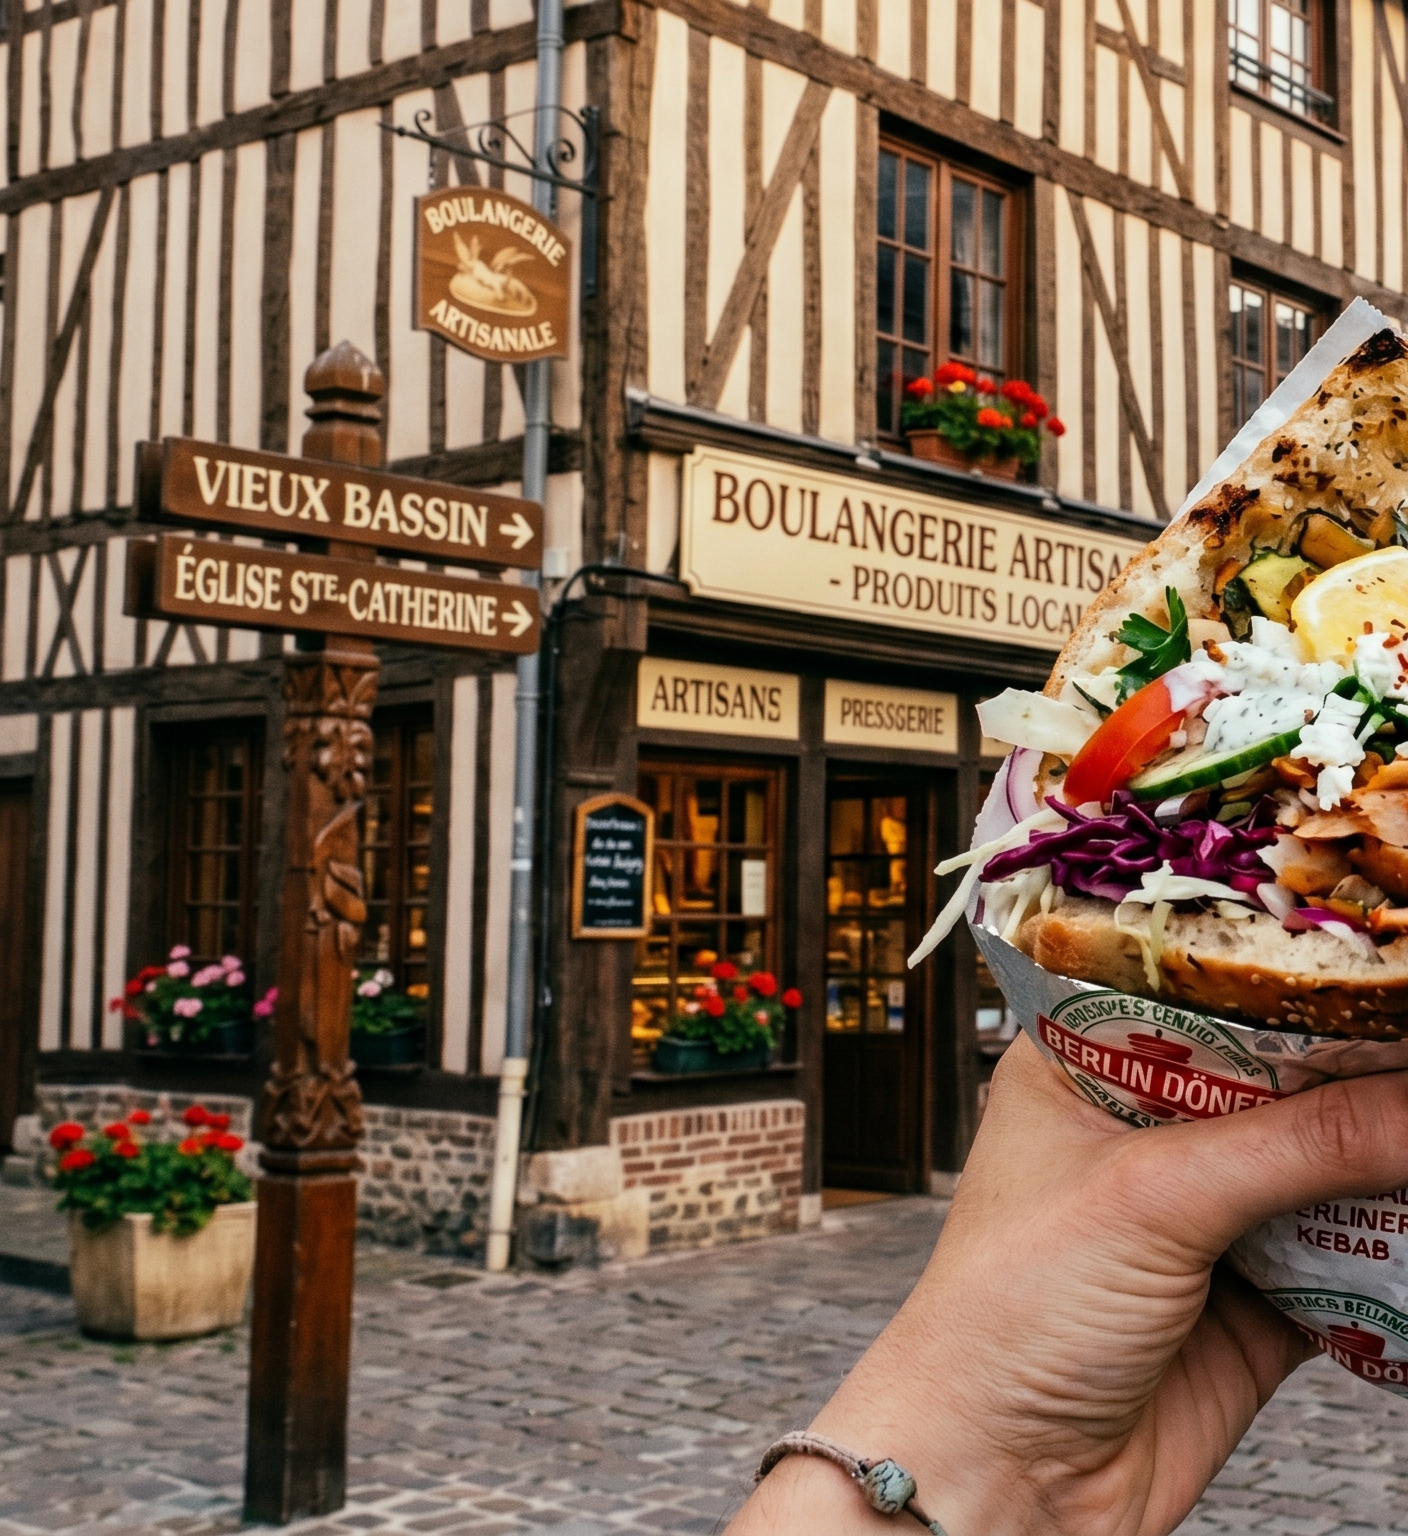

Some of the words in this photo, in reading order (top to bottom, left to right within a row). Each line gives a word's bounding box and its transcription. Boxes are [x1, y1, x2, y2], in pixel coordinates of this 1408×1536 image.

[424, 196, 567, 268] BOULANGERIE
[428, 298, 557, 352] ARTISANALE
[193, 456, 331, 523] VIEUX
[343, 482, 489, 547] BASSIN
[712, 470, 998, 574] BOULANGERIE
[1009, 532, 1131, 593] ARTISA
[174, 543, 283, 612] ÉGLISE
[852, 565, 999, 623] PRODUITS
[651, 674, 783, 723] ARTISANS
[1046, 1024, 1154, 1094] BERLIN
[1296, 1224, 1390, 1261] KEBAB
